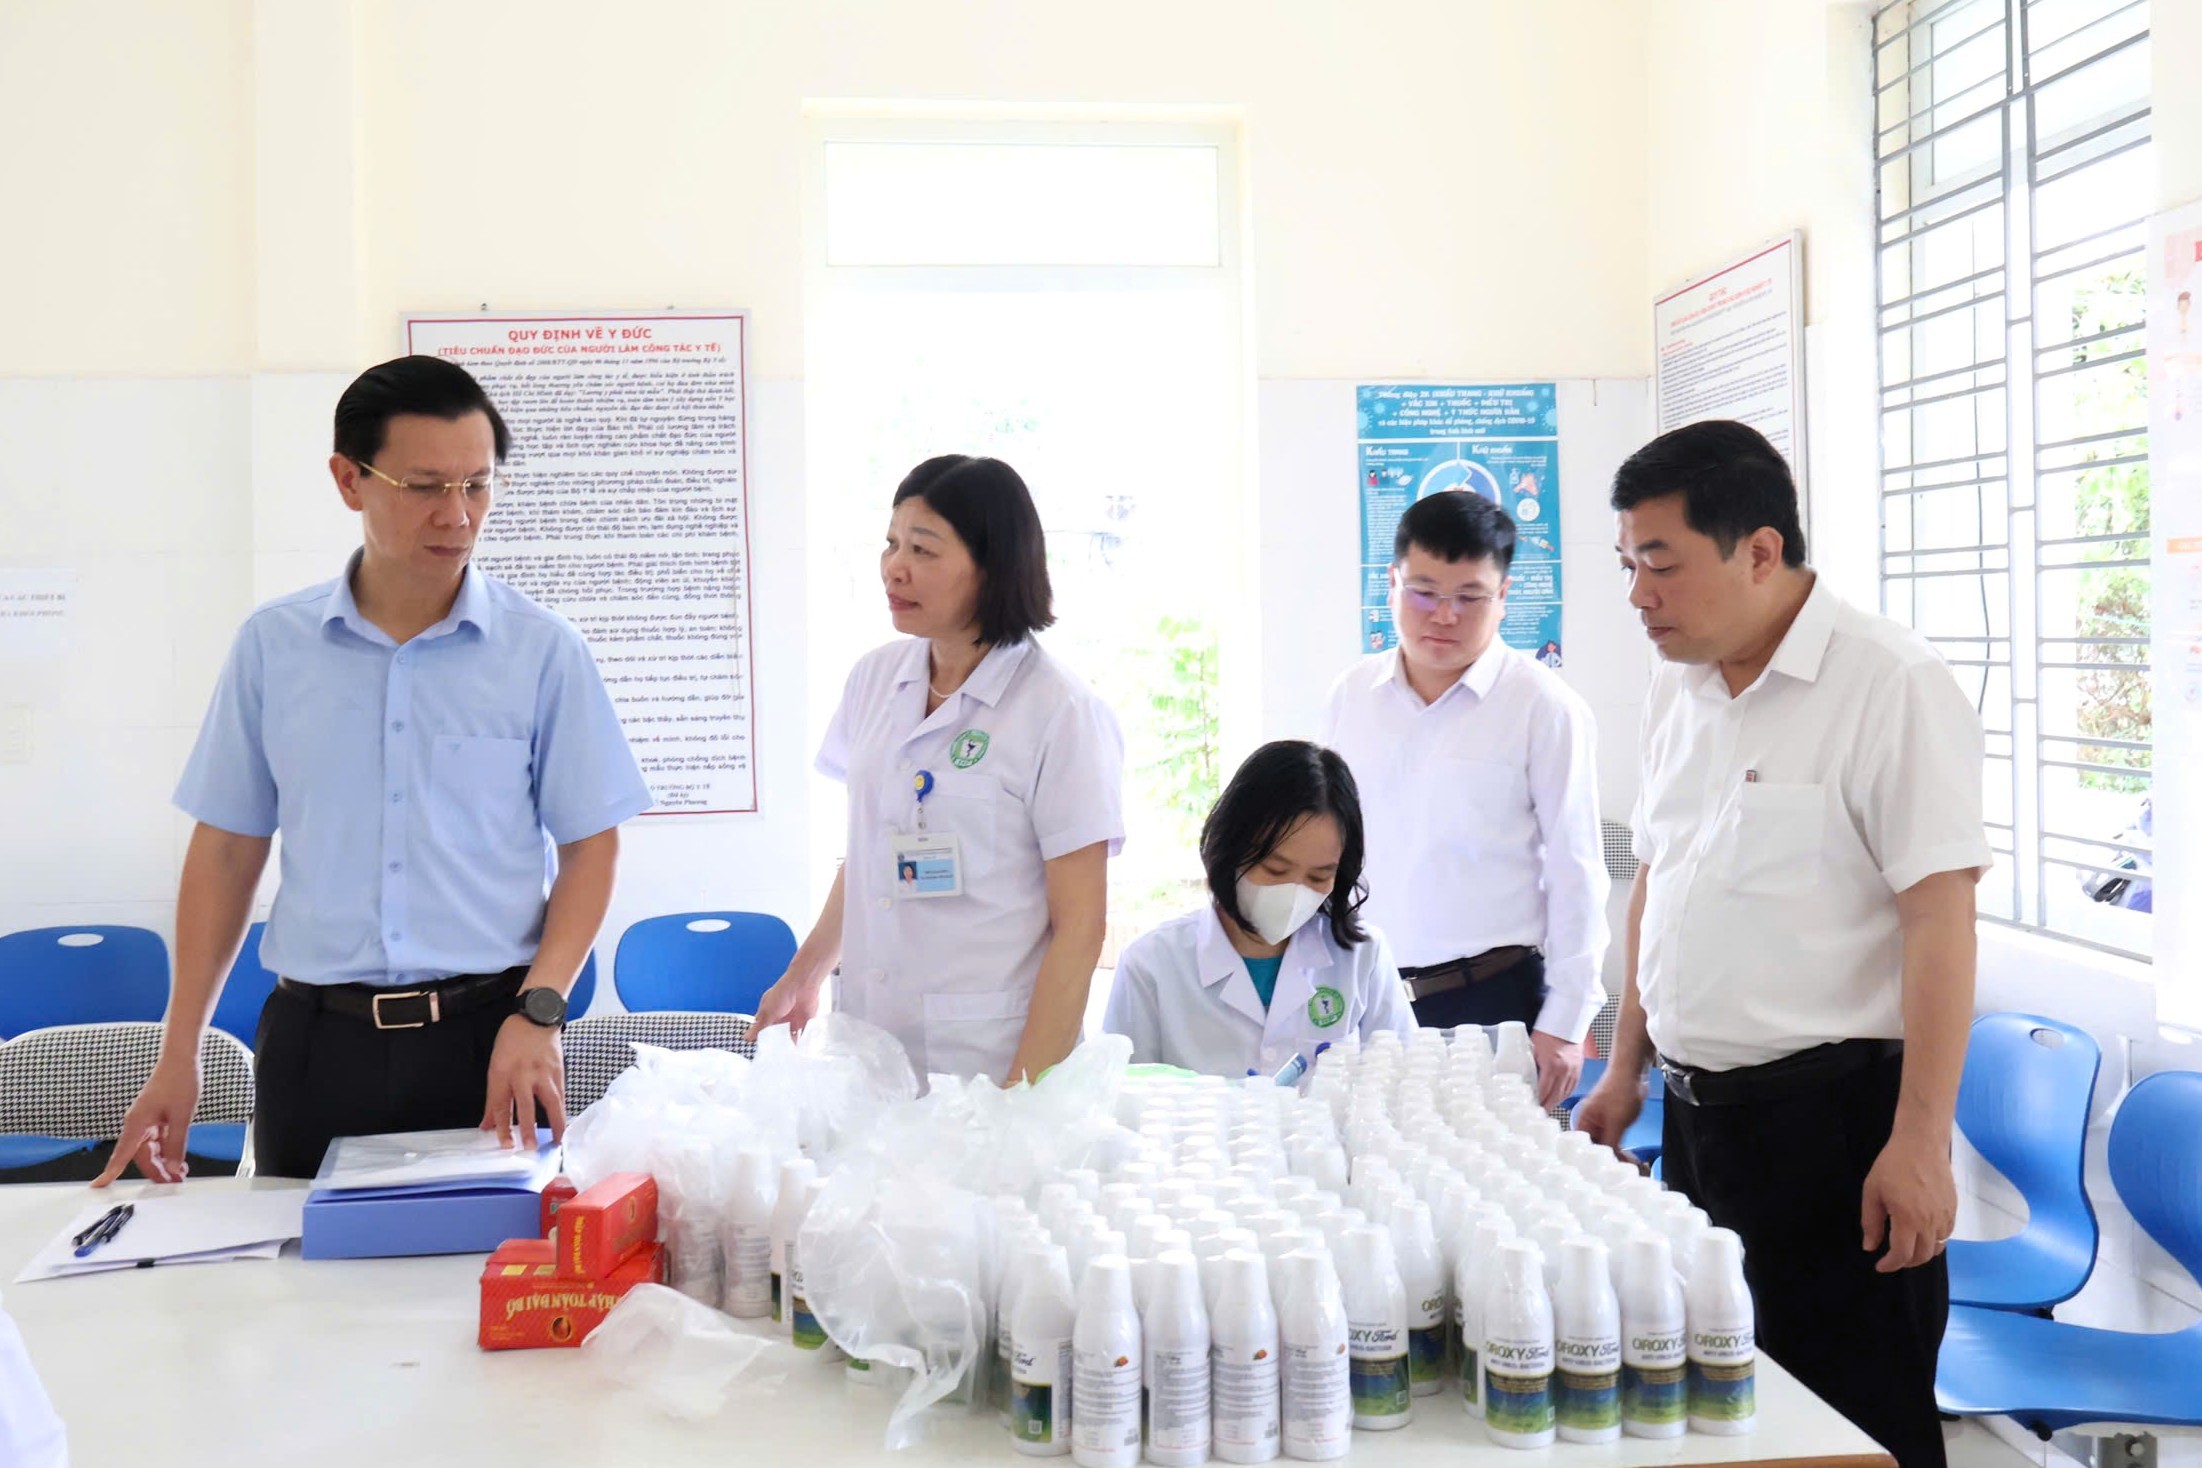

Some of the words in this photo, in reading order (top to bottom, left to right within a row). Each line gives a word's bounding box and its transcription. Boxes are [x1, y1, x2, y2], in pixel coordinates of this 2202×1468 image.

[508, 330, 537, 343] QUY
[542, 329, 580, 342] ĐỊNH
[586, 327, 602, 339] VỀ
[609, 329, 616, 339] Y
[621, 326, 651, 339] ĐỨC
[507, 347, 530, 356] ĐẠO
[532, 345, 554, 354] ĐỨC
[618, 344, 638, 353] LÀM
[642, 343, 670, 353] CÔNG
[673, 343, 692, 352] TÁC
[526, 1293, 550, 1310] ĐẠI
[551, 1293, 586, 1311] TOÀN
[1631, 1337, 1677, 1352] OROXY
[1694, 1333, 1740, 1349] OROXY
